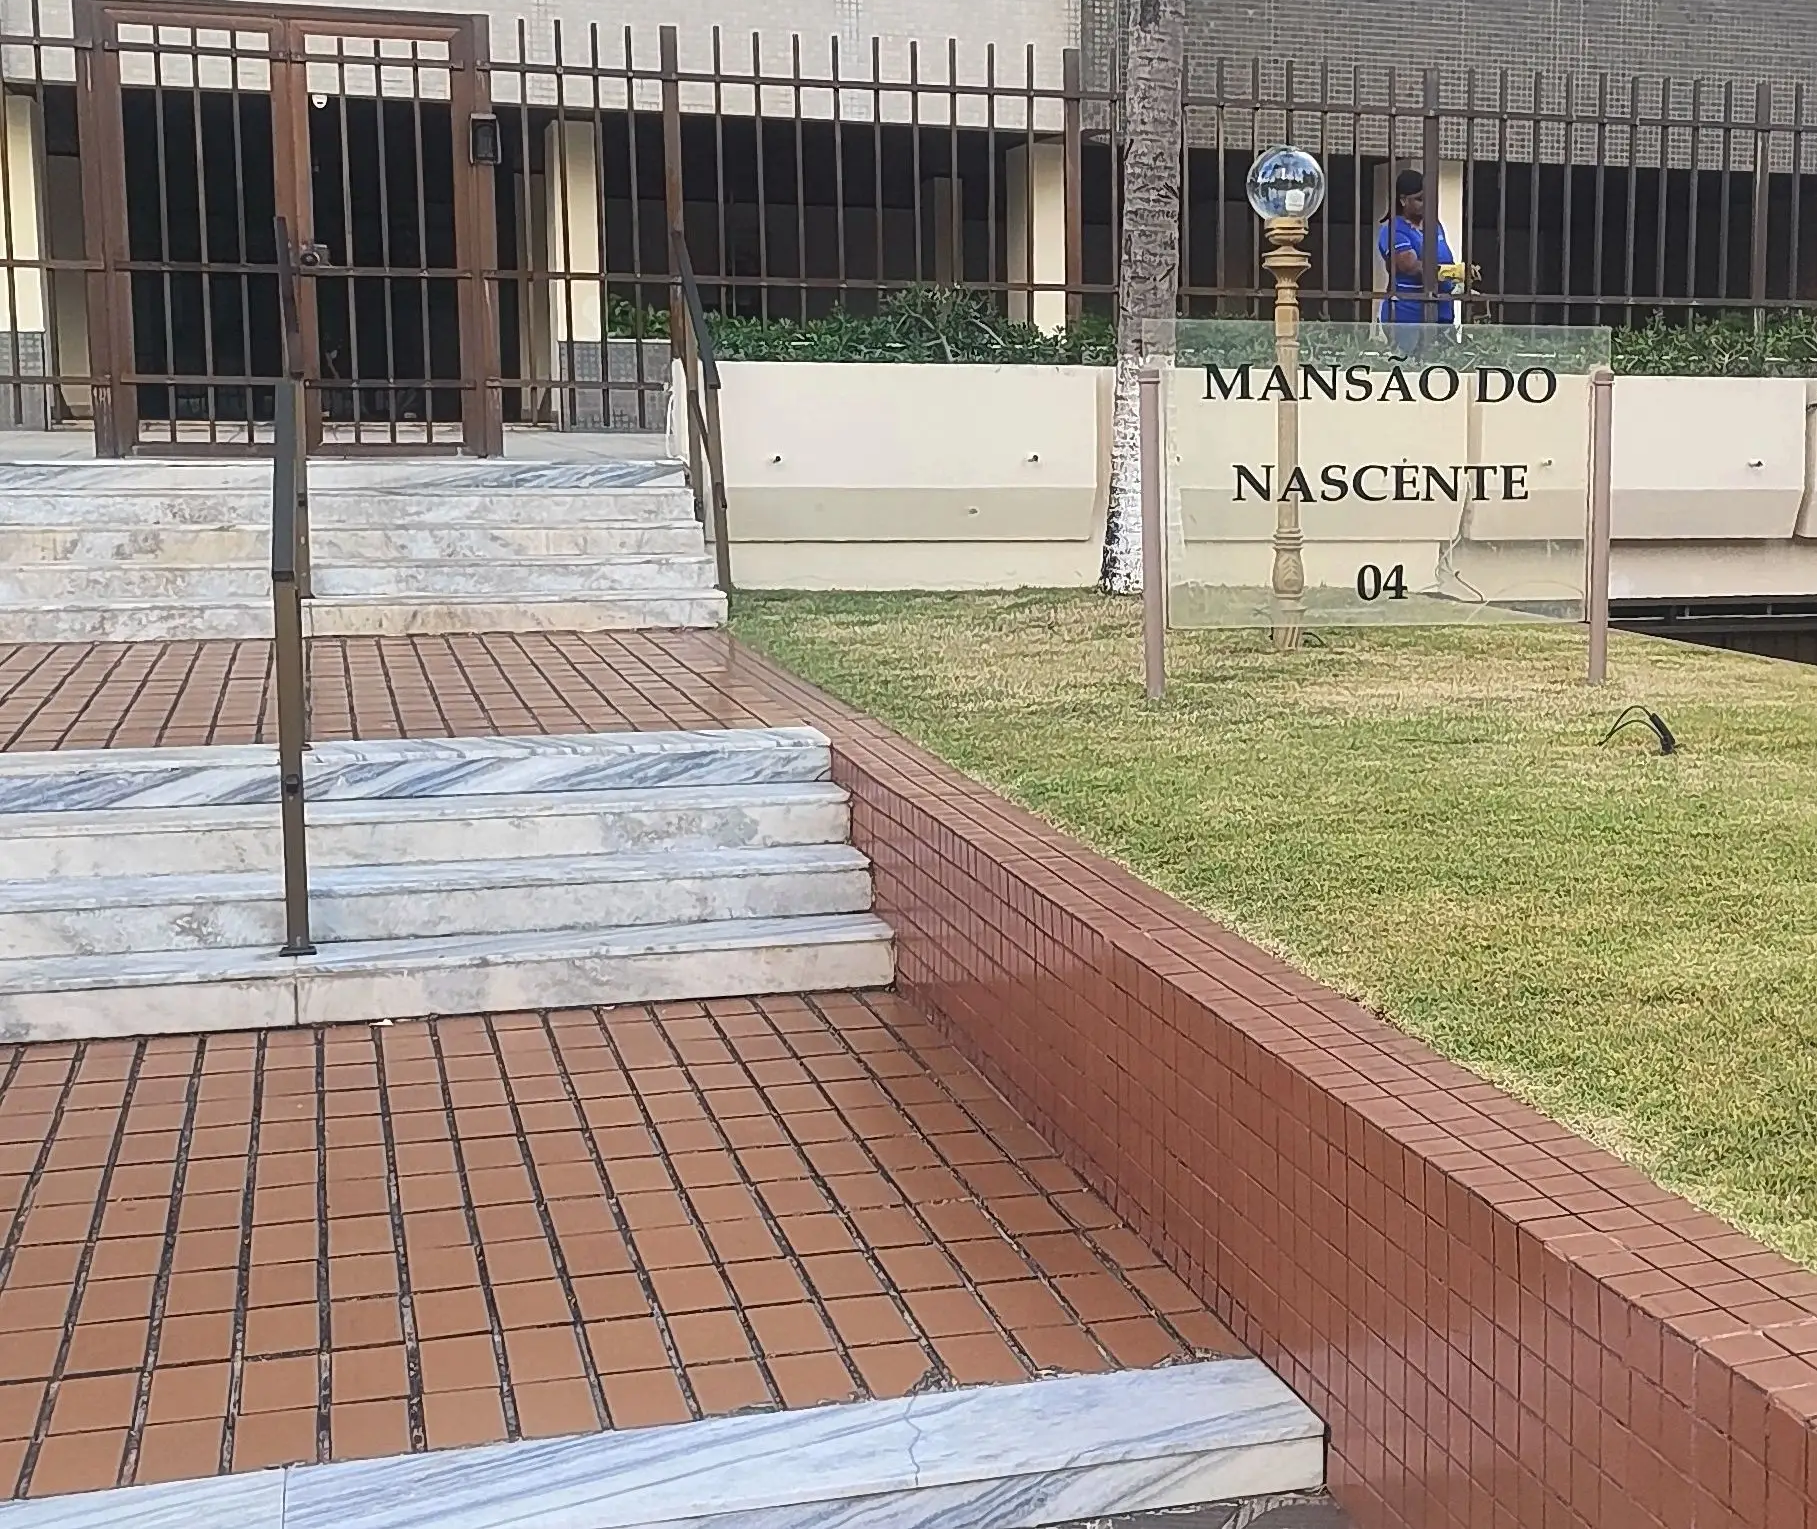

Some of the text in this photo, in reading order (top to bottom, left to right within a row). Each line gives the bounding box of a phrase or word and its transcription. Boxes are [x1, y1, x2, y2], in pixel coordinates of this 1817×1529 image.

[1202, 356, 1558, 404] MANSÃO DO
[1231, 463, 1529, 503] NASCENTE
[1356, 563, 1408, 601] 04
